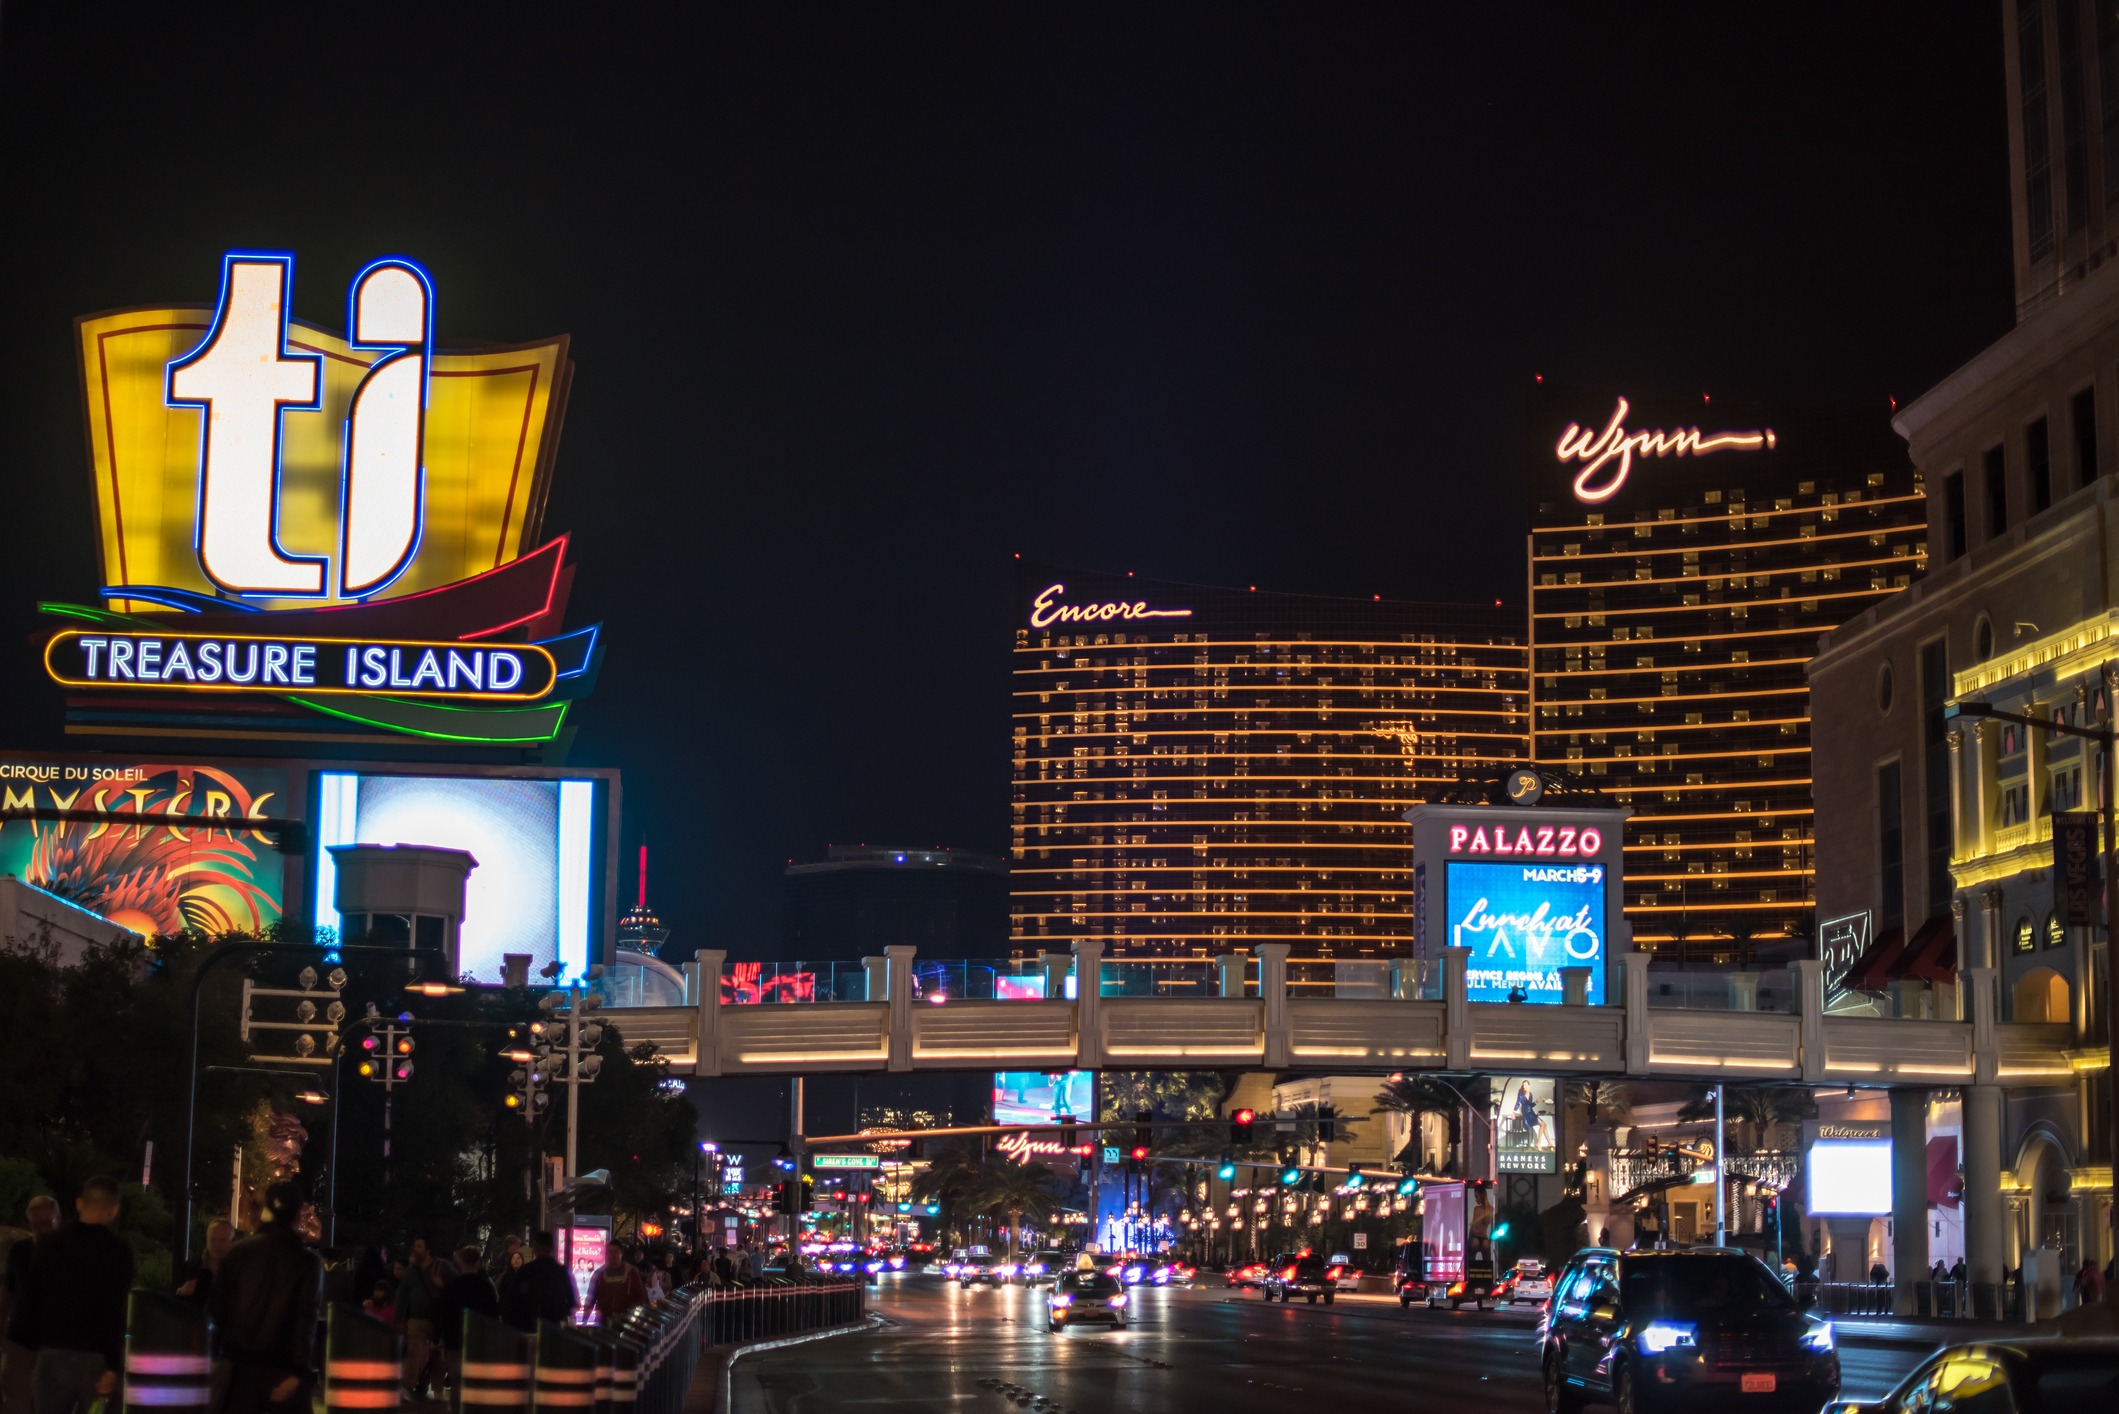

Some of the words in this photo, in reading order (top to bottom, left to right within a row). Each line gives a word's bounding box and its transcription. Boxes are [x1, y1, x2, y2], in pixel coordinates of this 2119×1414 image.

[166, 250, 432, 601] ti
[1031, 583, 1193, 629] Encore
[80, 639, 316, 684] TREASURE
[346, 646, 523, 690] ISLAND
[0, 765, 60, 783] CIRQUE
[65, 768, 89, 780] DU
[92, 768, 149, 782] SOLEIL
[2055, 816, 2086, 825] WELCOME
[2088, 816, 2096, 825] TO
[1450, 825, 1602, 857] PALAZZO
[2066, 828, 2088, 886] VEGAS
[1461, 897, 1556, 932] Lunch
[1555, 904, 1592, 931] at
[2068, 887, 2089, 922] LAS
[1467, 970, 1503, 980] ERVICE
[1506, 970, 1544, 981] BEGINS
[1467, 980, 1487, 989] ULL
[1492, 980, 1524, 989] MENU
[1819, 1125, 1881, 1140] Walgreens
[847, 1157, 864, 1166] COVE
